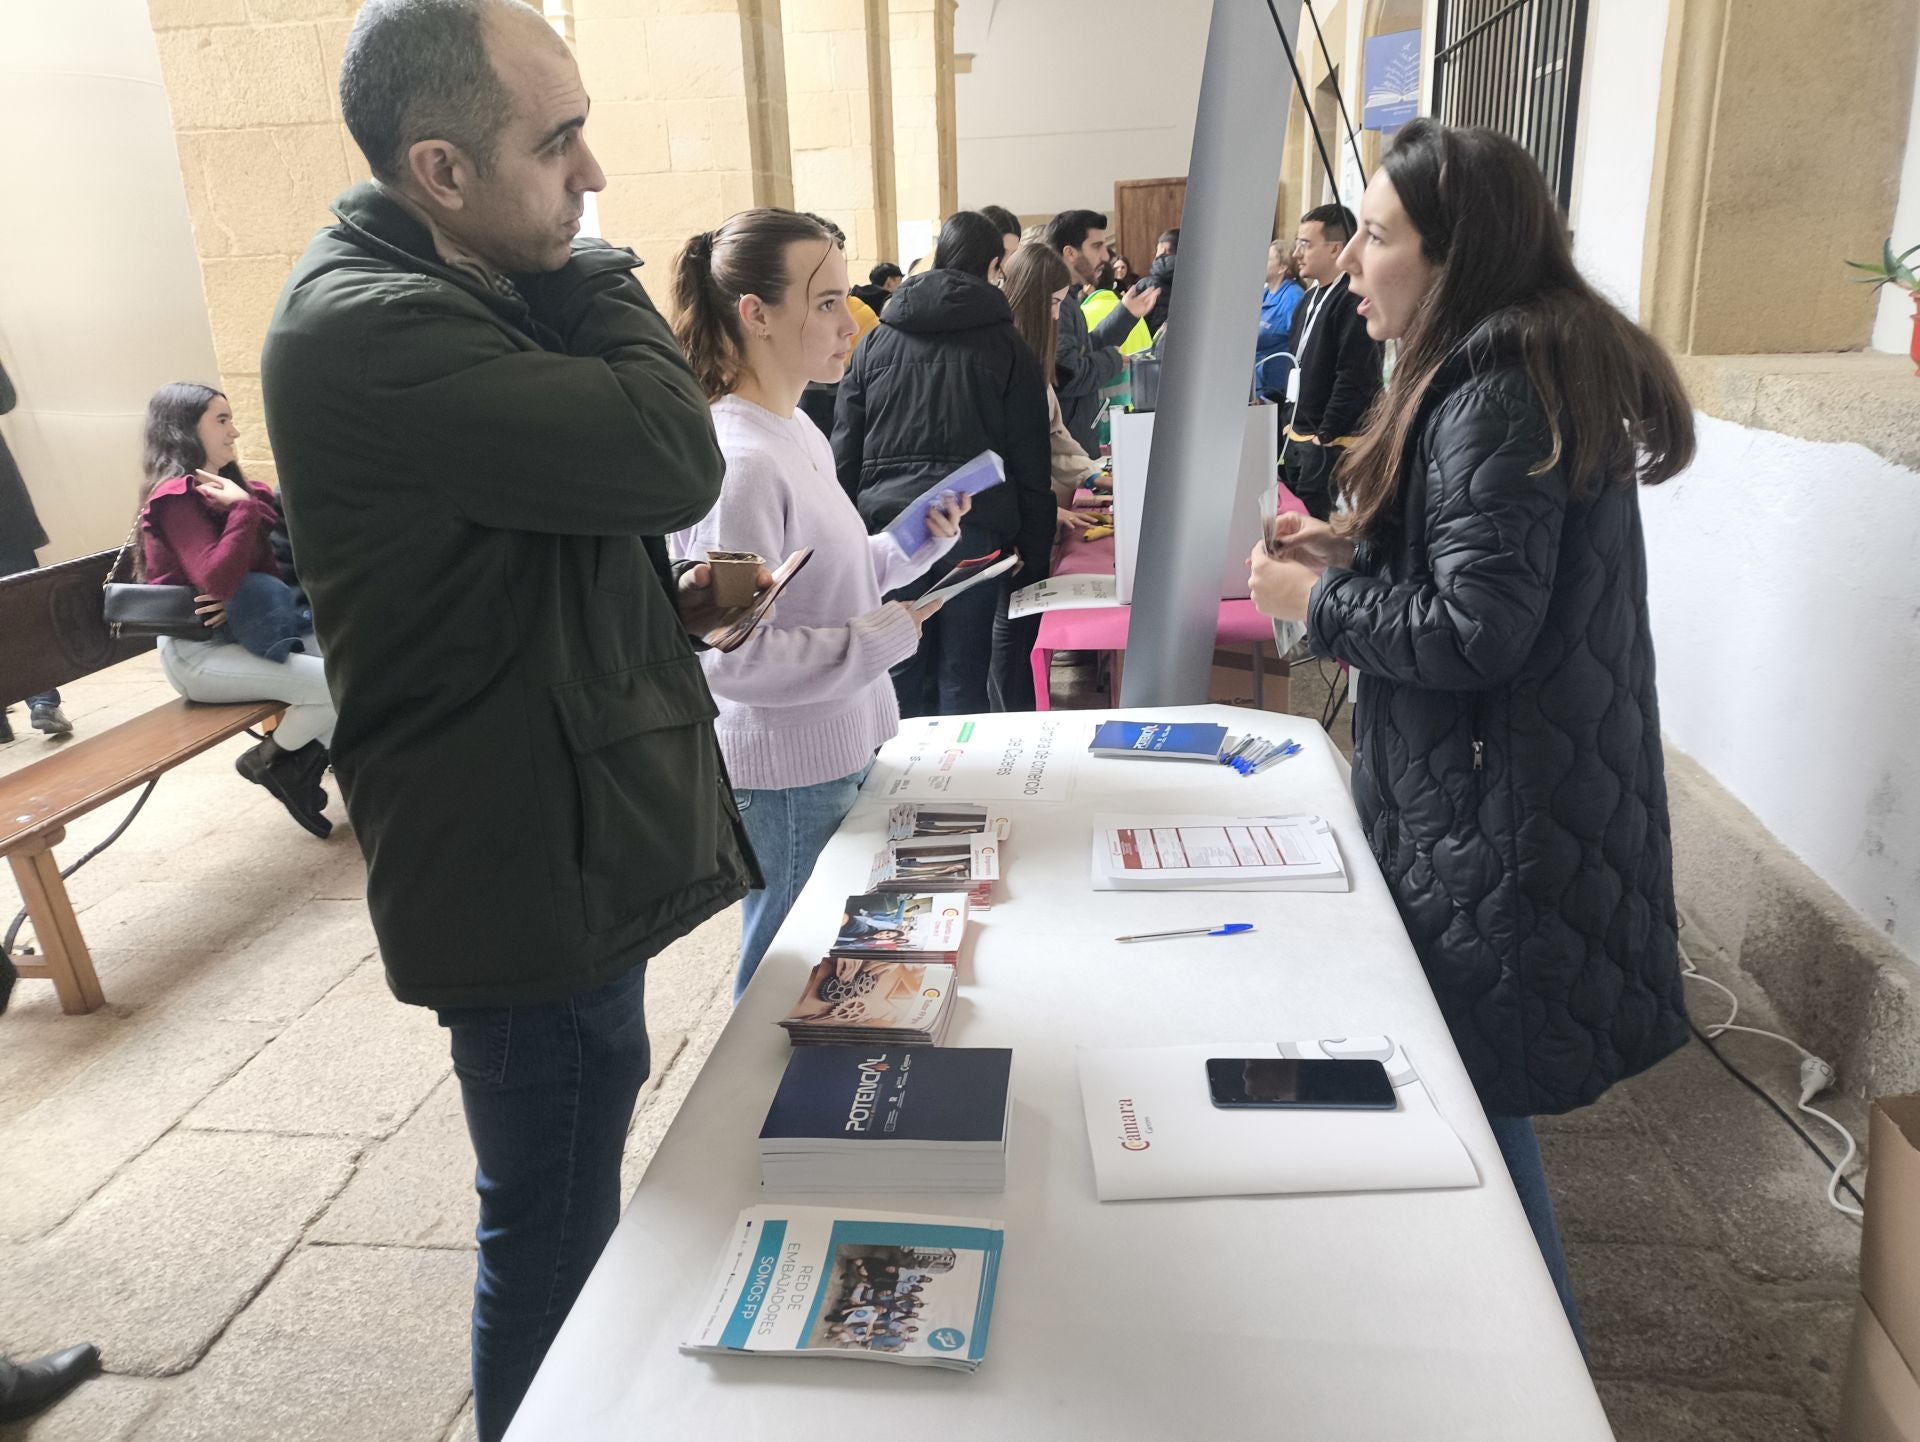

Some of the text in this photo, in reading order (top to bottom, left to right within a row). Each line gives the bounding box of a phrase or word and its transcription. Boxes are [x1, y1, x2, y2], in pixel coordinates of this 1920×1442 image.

[1024, 760, 1047, 796] comercio
[1117, 1098, 1150, 1152] Cámara
[757, 1242, 801, 1336] EMBAJADORES
[786, 1265, 814, 1312] RED DE
